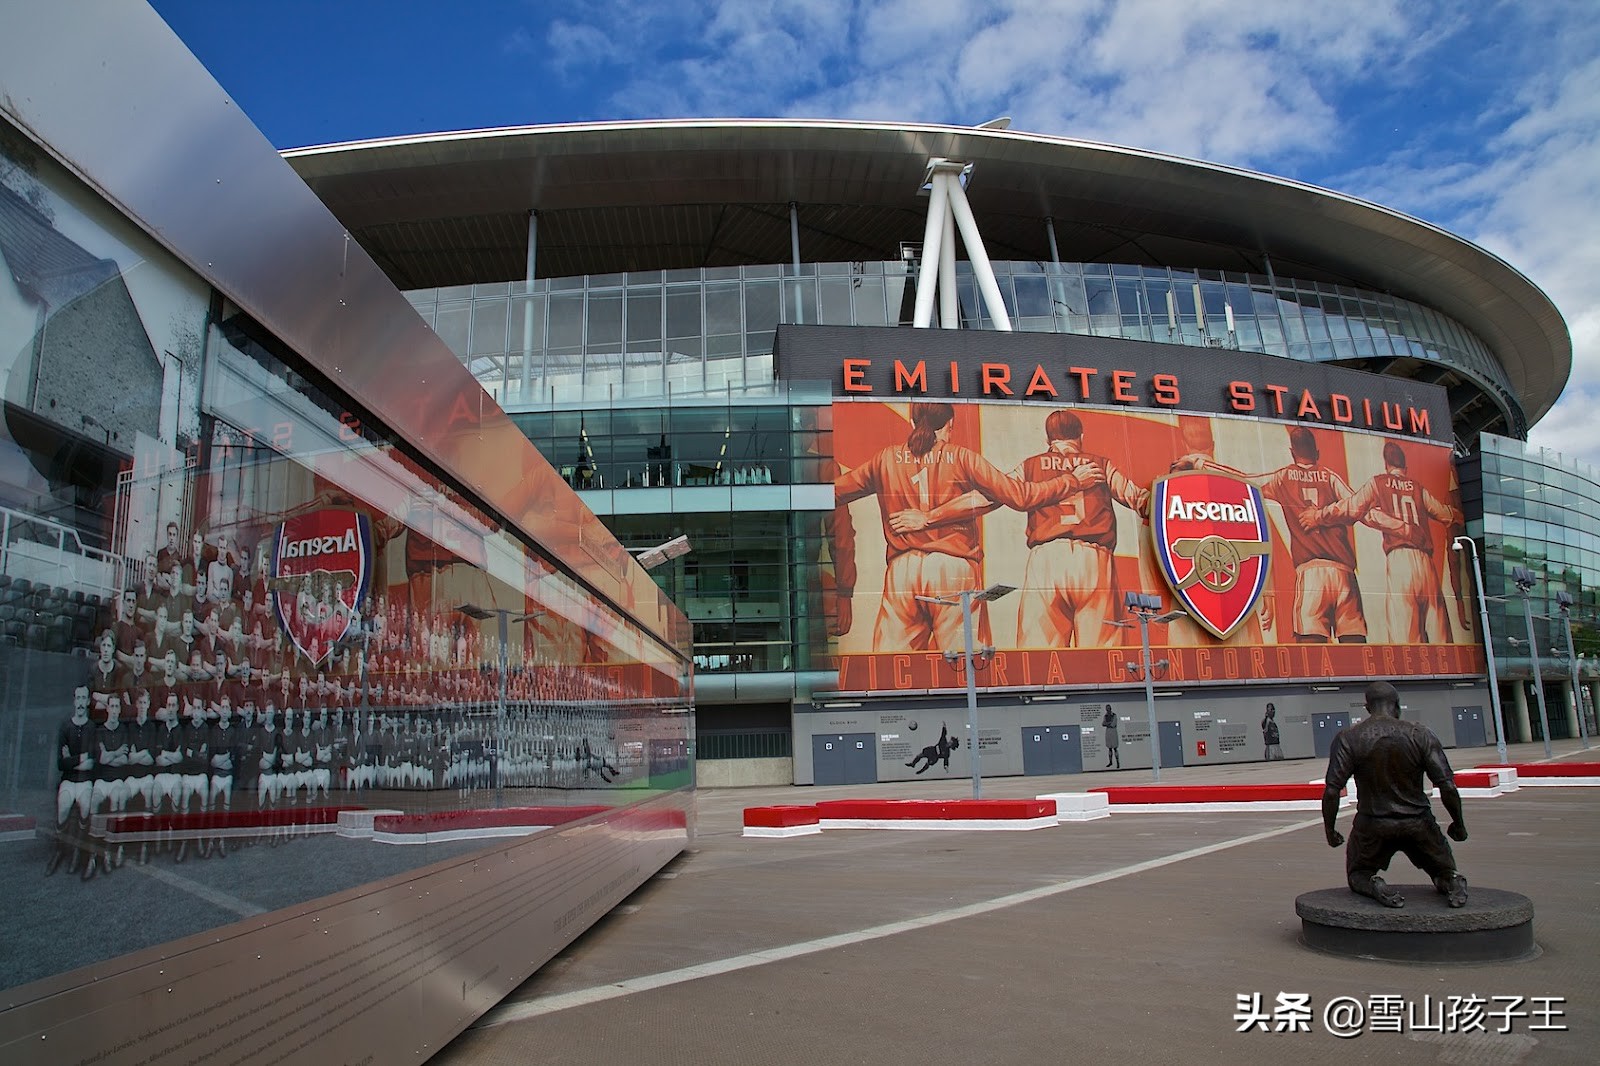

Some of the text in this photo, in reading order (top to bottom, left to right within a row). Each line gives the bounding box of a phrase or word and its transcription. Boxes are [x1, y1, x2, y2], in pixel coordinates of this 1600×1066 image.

[843, 358, 1431, 436] EMIRATES STADIUM
[910, 466, 930, 513] 1
[1288, 469, 1329, 483] ROCASTLE
[1384, 477, 1414, 491] JAMES
[1168, 494, 1255, 523] Arsenal
[1108, 645, 1335, 683] CONCORDIA
[1361, 645, 1476, 676] CRESCIT
